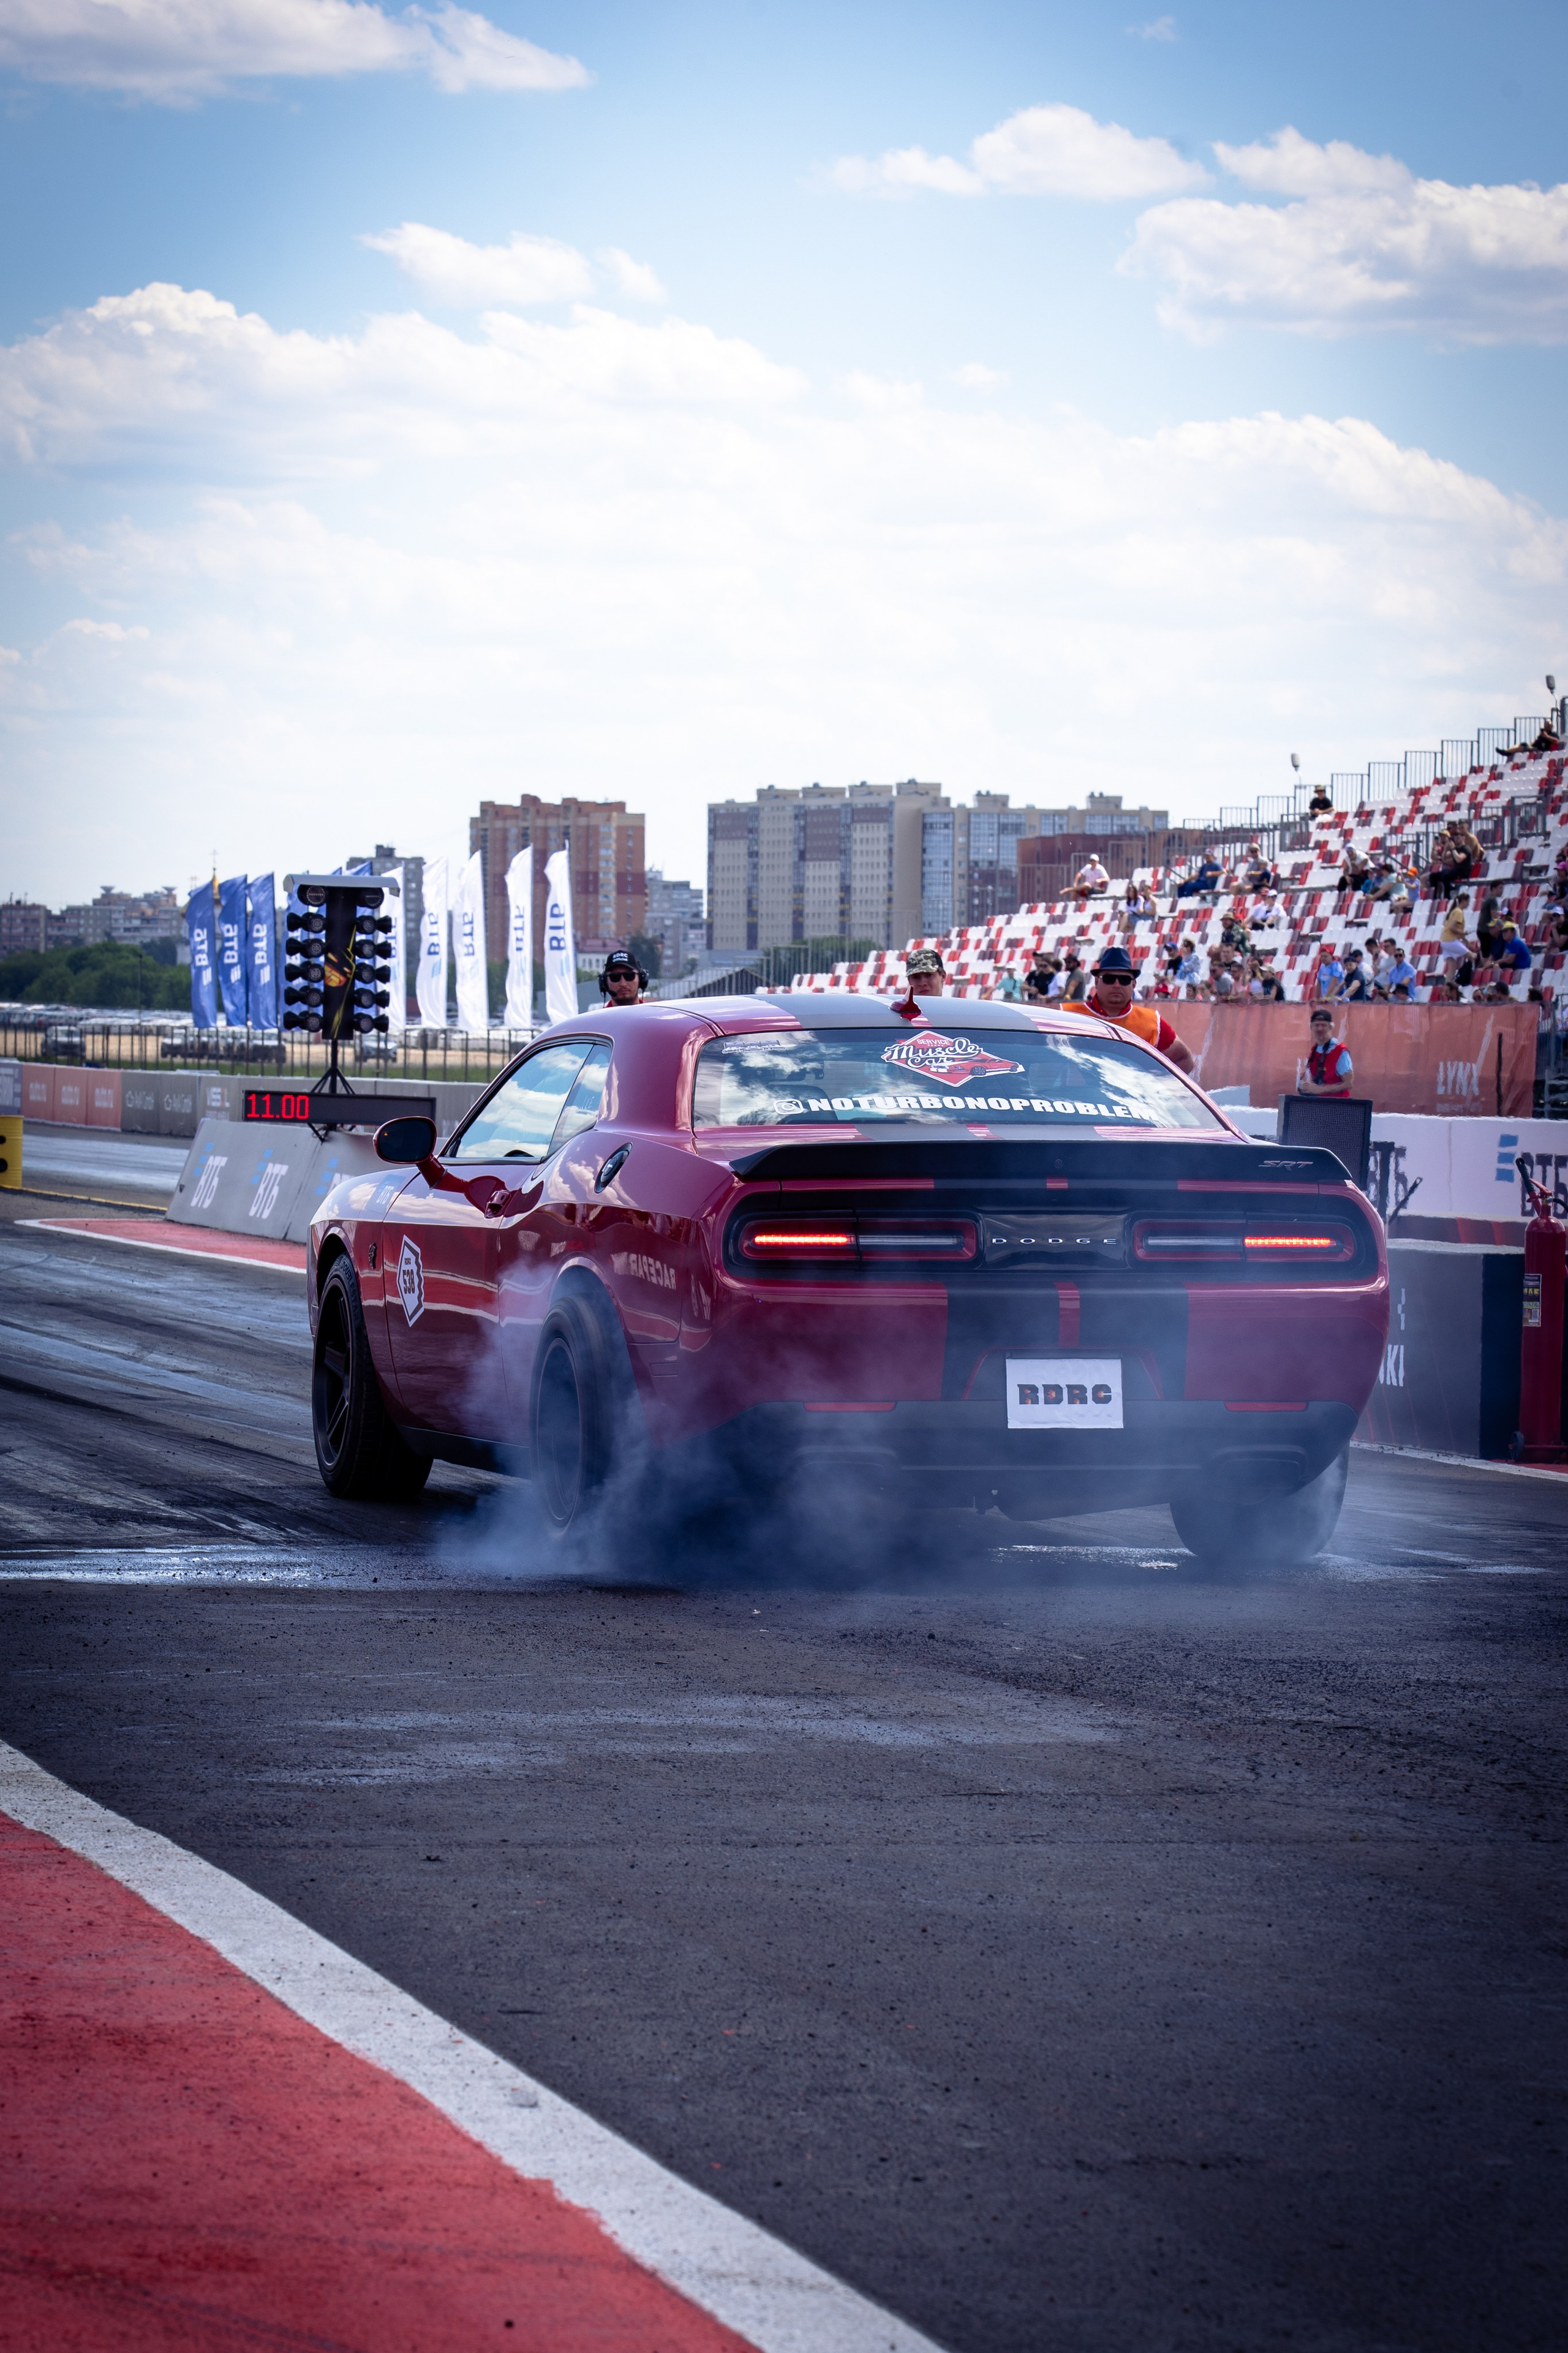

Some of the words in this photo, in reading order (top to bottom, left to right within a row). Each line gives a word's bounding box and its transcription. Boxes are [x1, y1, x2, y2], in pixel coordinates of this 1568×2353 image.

[888, 1037, 982, 1060] Muscle
[907, 1056, 953, 1068] Car
[1436, 1060, 1479, 1097] LYNX
[247, 1093, 309, 1120] 11.00
[807, 1096, 1159, 1121] NOTURBONOPROBLEM
[1258, 1160, 1313, 1171] SRT
[190, 1155, 228, 1209] ВТБ
[249, 1163, 288, 1219] ВТБ
[376, 1185, 395, 1204] ВТБ
[402, 1269, 415, 1294] 538
[1017, 1384, 1112, 1405] RDRC
